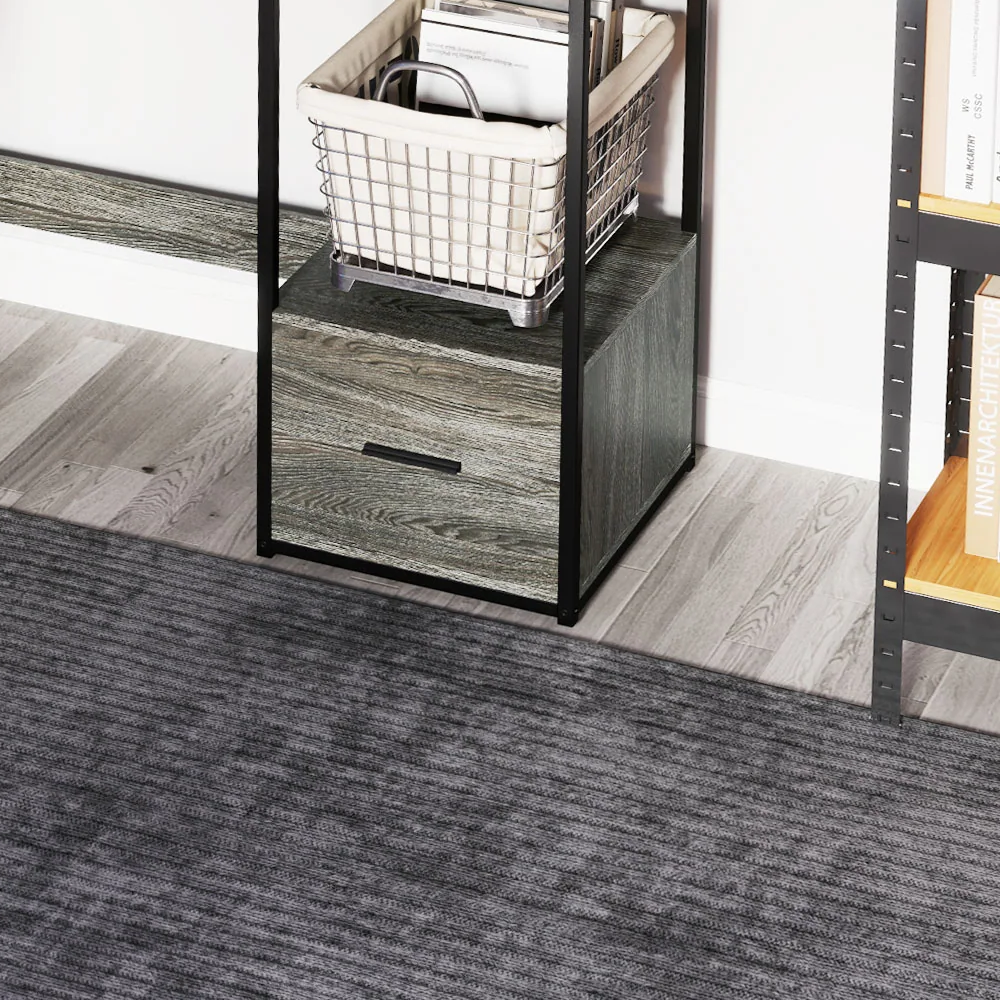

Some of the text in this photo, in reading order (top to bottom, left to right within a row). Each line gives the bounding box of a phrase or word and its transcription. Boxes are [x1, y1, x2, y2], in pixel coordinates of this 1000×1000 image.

[961, 98, 970, 113] WS
[973, 93, 983, 120] CSSC
[965, 134, 976, 190] PAUL McCARTHY
[974, 299, 1000, 517] INNENARCHITEKTUR
